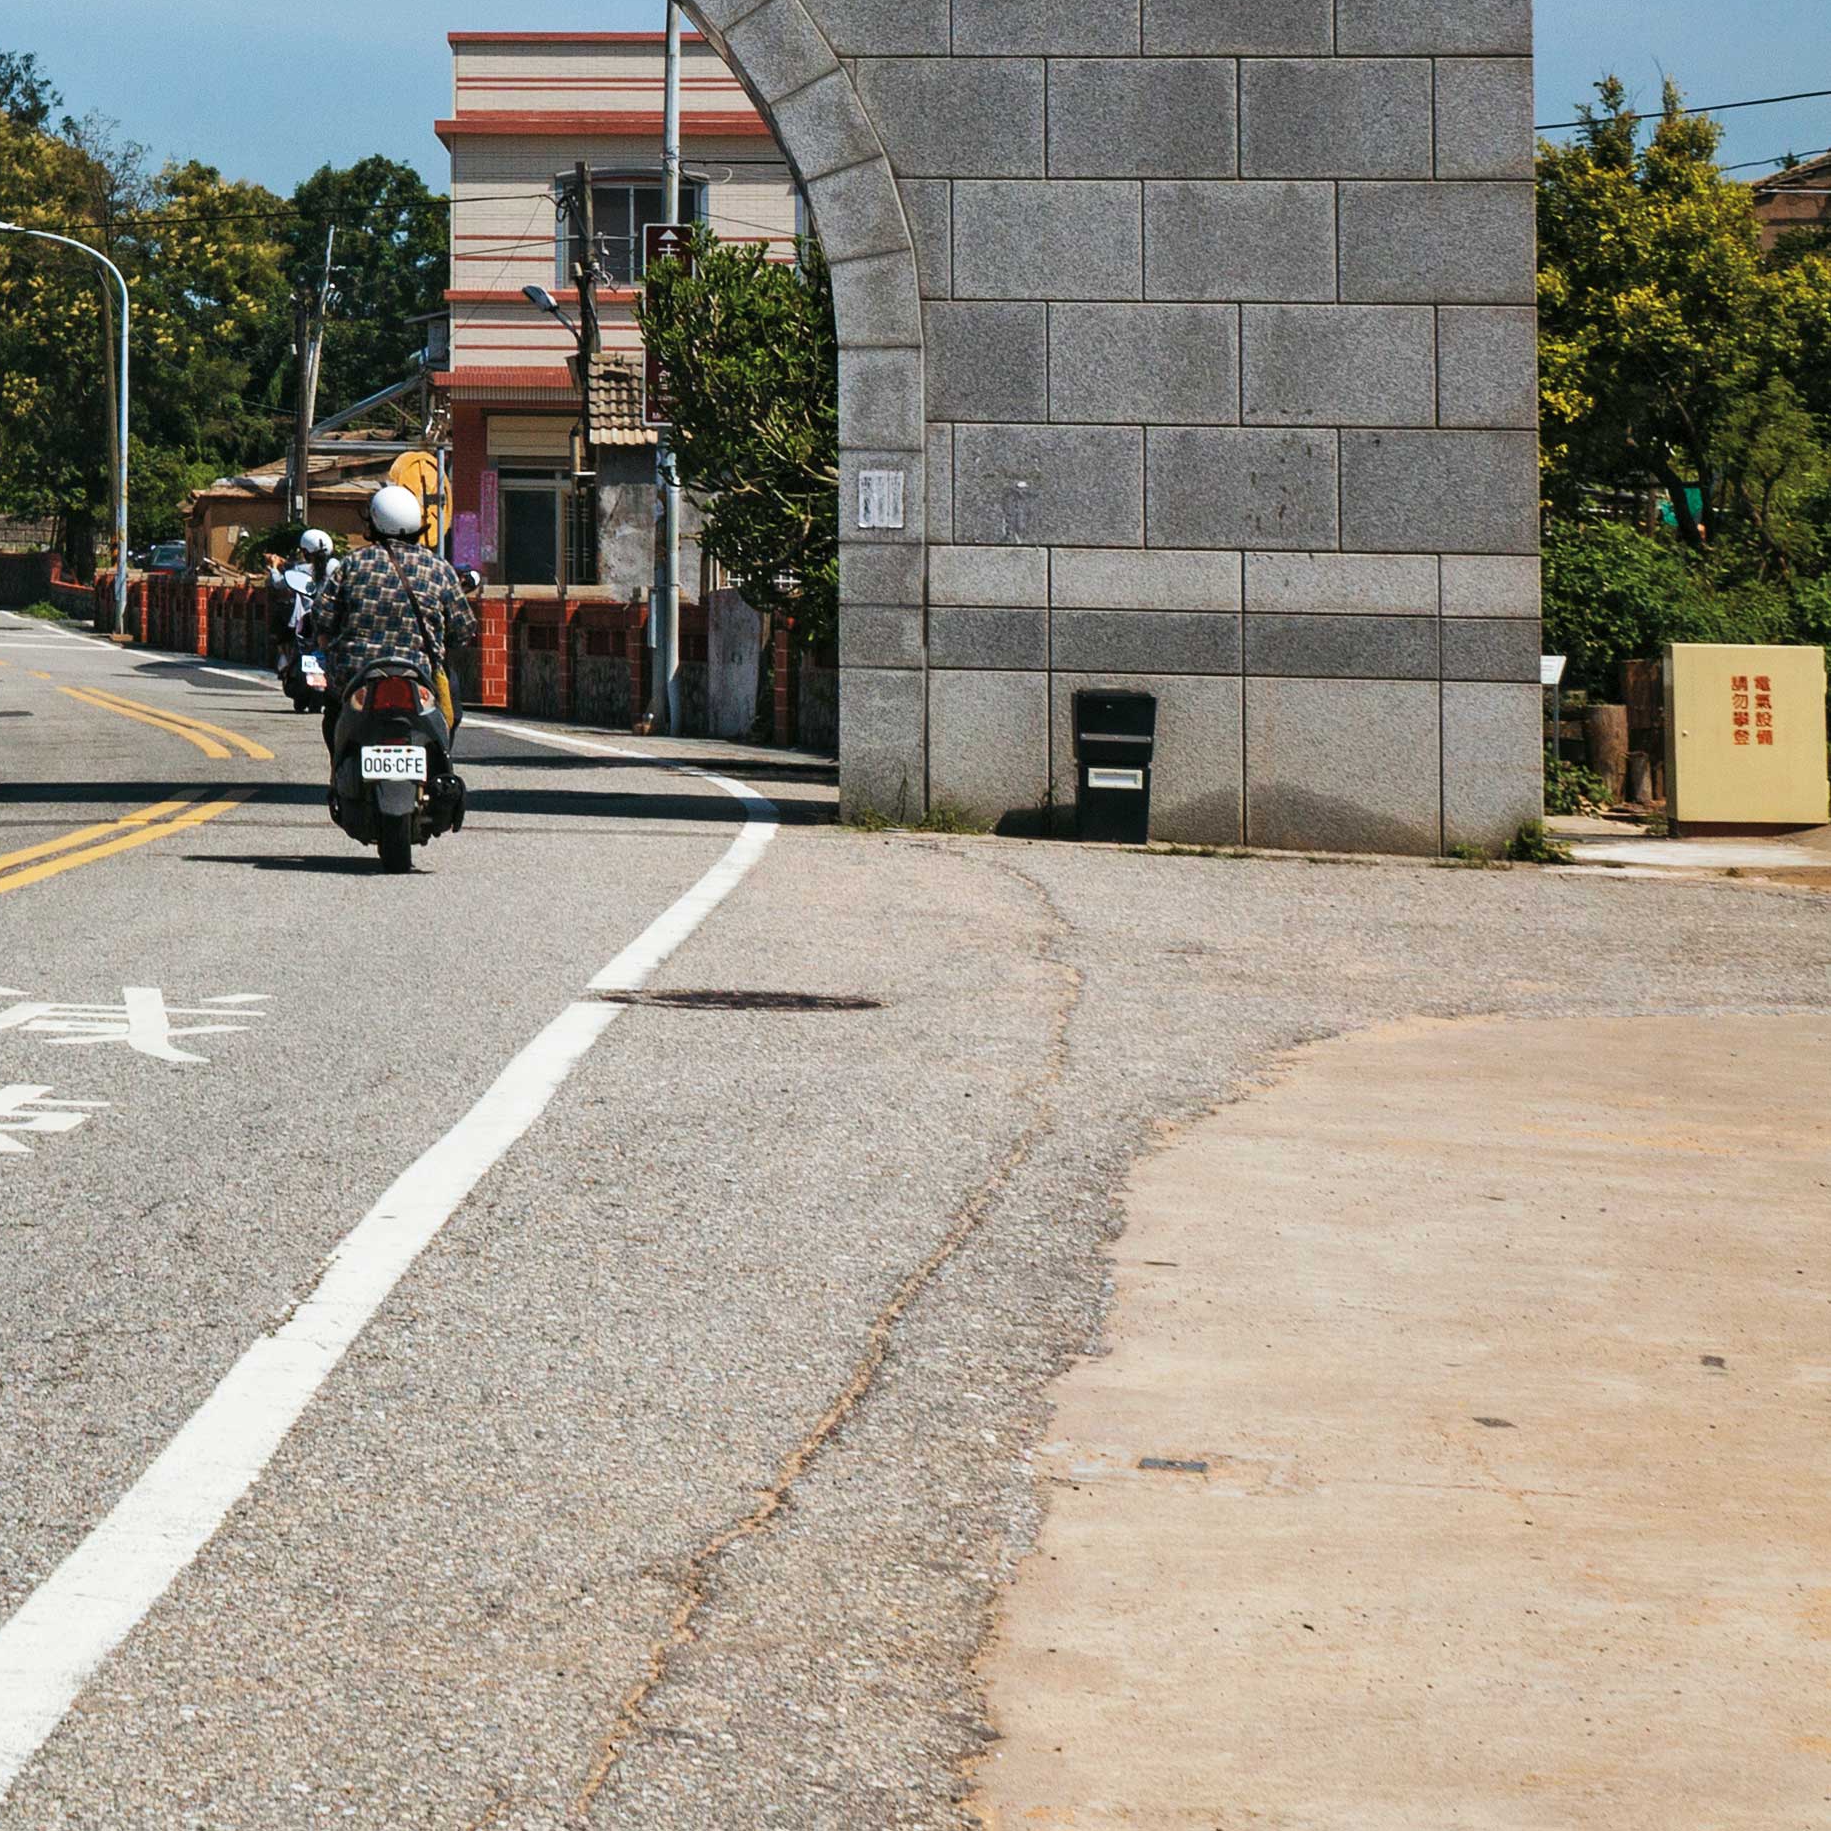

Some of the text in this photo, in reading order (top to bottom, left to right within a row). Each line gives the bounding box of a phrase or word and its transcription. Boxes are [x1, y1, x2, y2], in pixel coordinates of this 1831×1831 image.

[1731, 675, 1750, 746] 請勿攀登
[1754, 675, 1773, 746] 電氣設備
